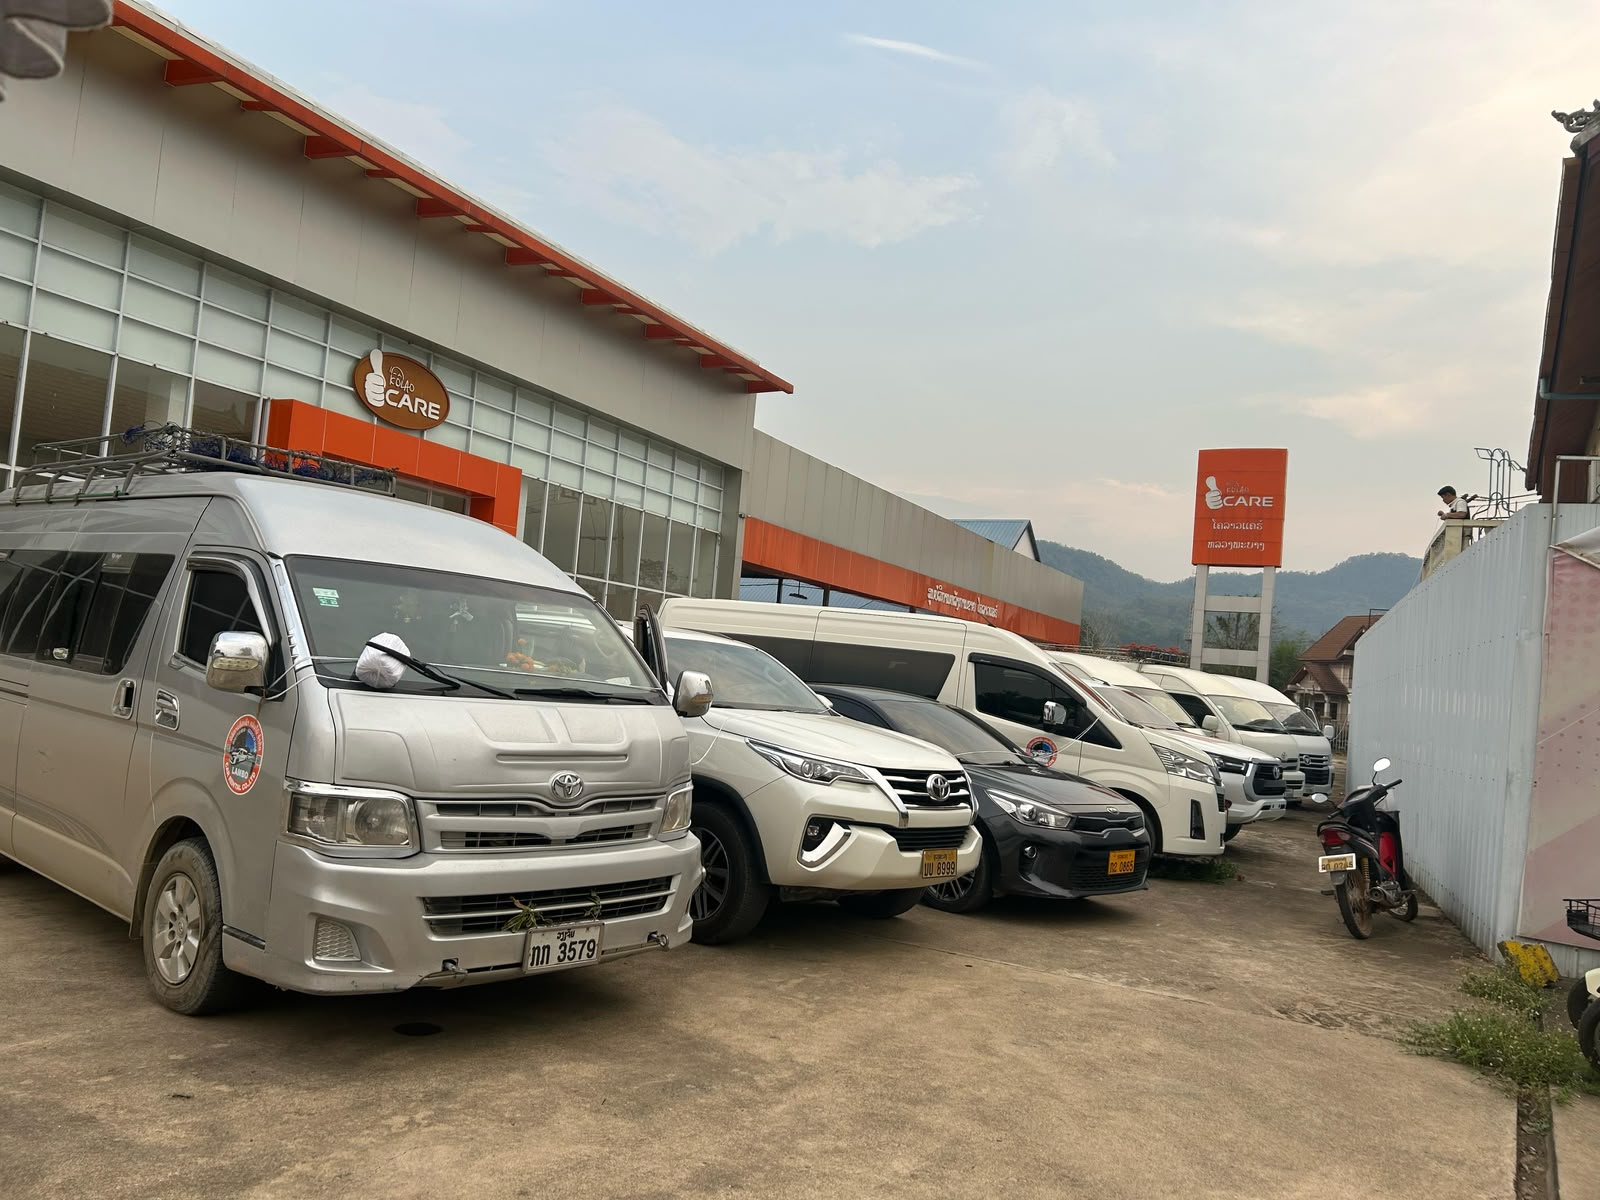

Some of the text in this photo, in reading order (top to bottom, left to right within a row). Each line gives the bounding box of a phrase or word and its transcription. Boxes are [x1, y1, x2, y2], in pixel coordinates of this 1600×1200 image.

[385, 389, 441, 420] CARE
[1223, 496, 1274, 508] CARE
[936, 861, 956, 875] 8999
[557, 938, 597, 963] 3579
